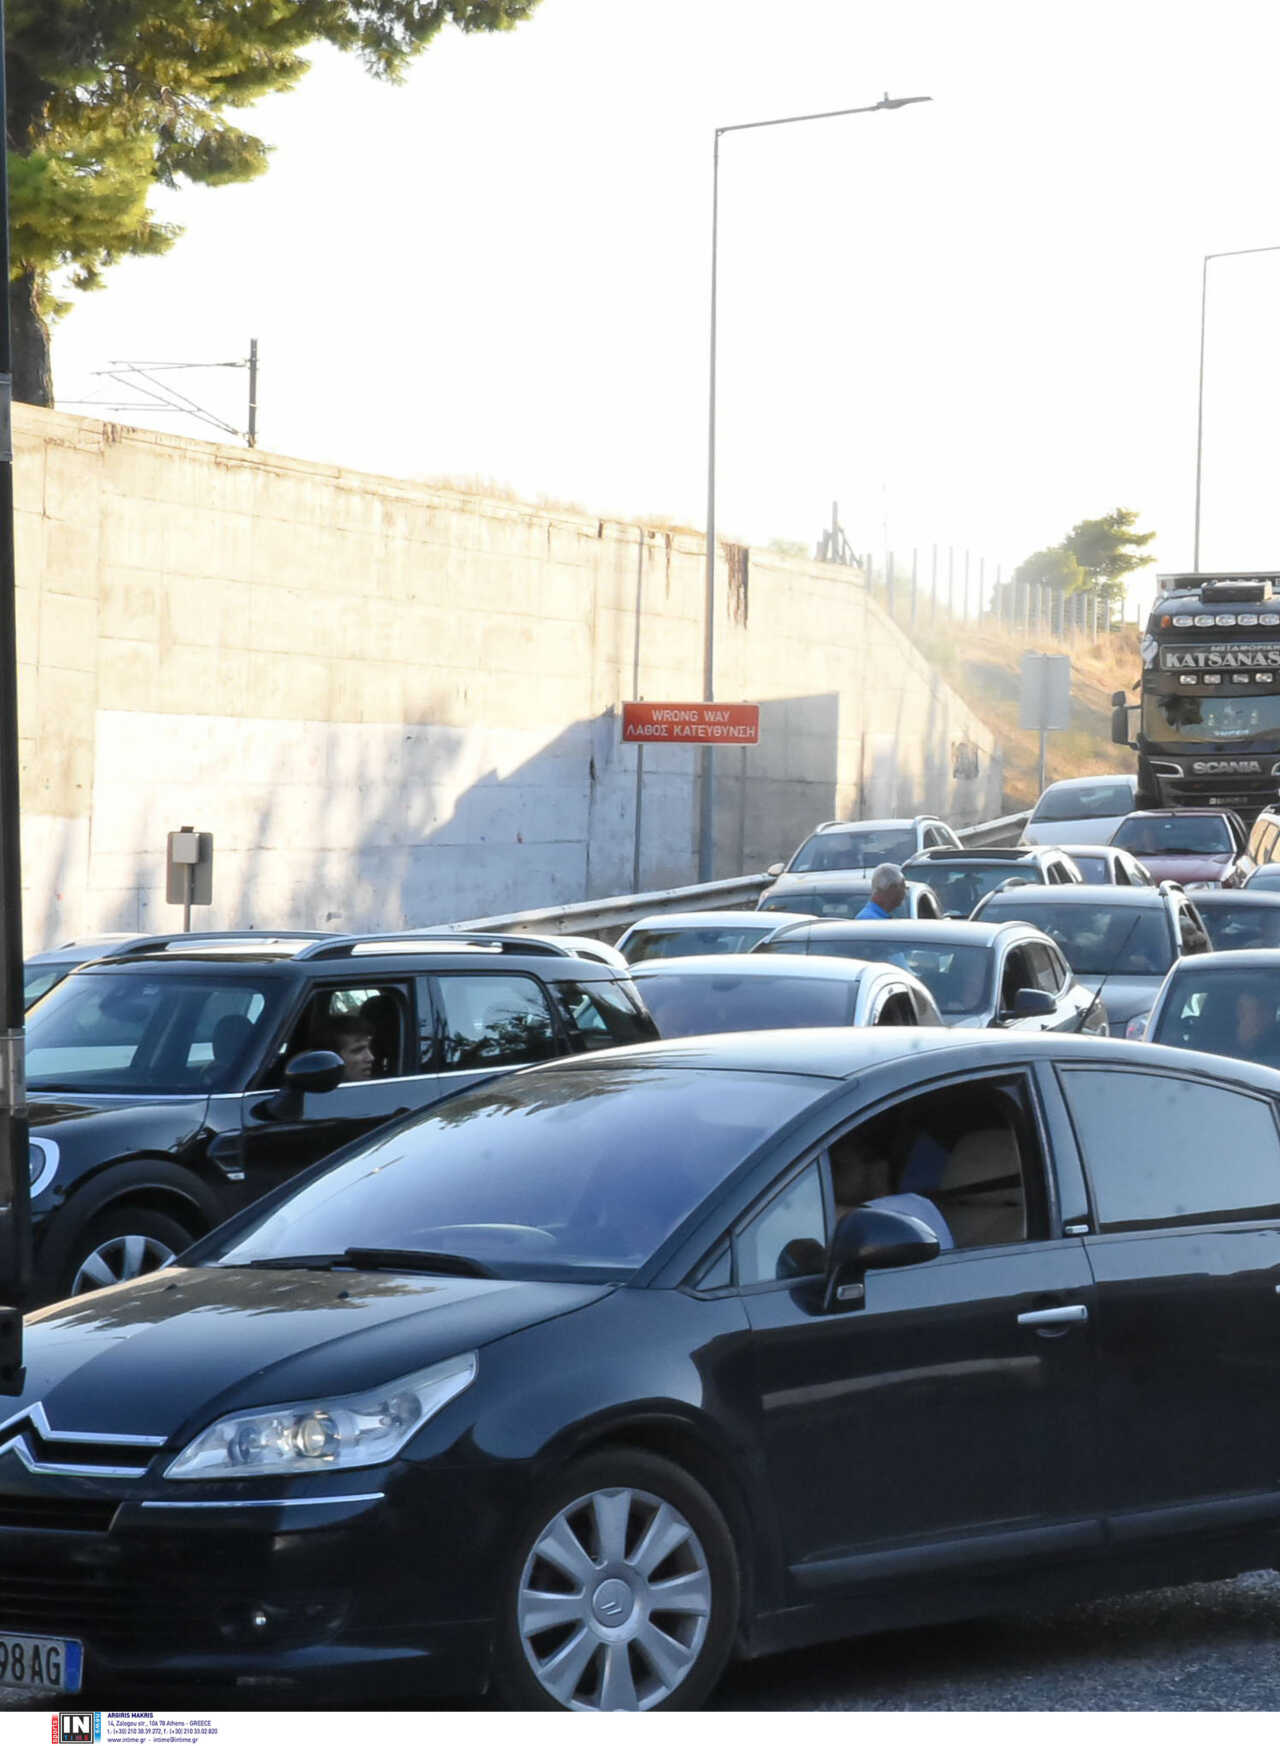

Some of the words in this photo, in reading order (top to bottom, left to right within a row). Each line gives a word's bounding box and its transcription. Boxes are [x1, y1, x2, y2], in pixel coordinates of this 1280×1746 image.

[652, 709, 698, 722] WRONG
[704, 710, 730, 722] WAY
[626, 724, 668, 736] ΛΑΘΟΣ
[673, 725, 755, 737] ΚΑΤΕΥΘΥΝΣΗ
[1192, 761, 1262, 774] SCANIA
